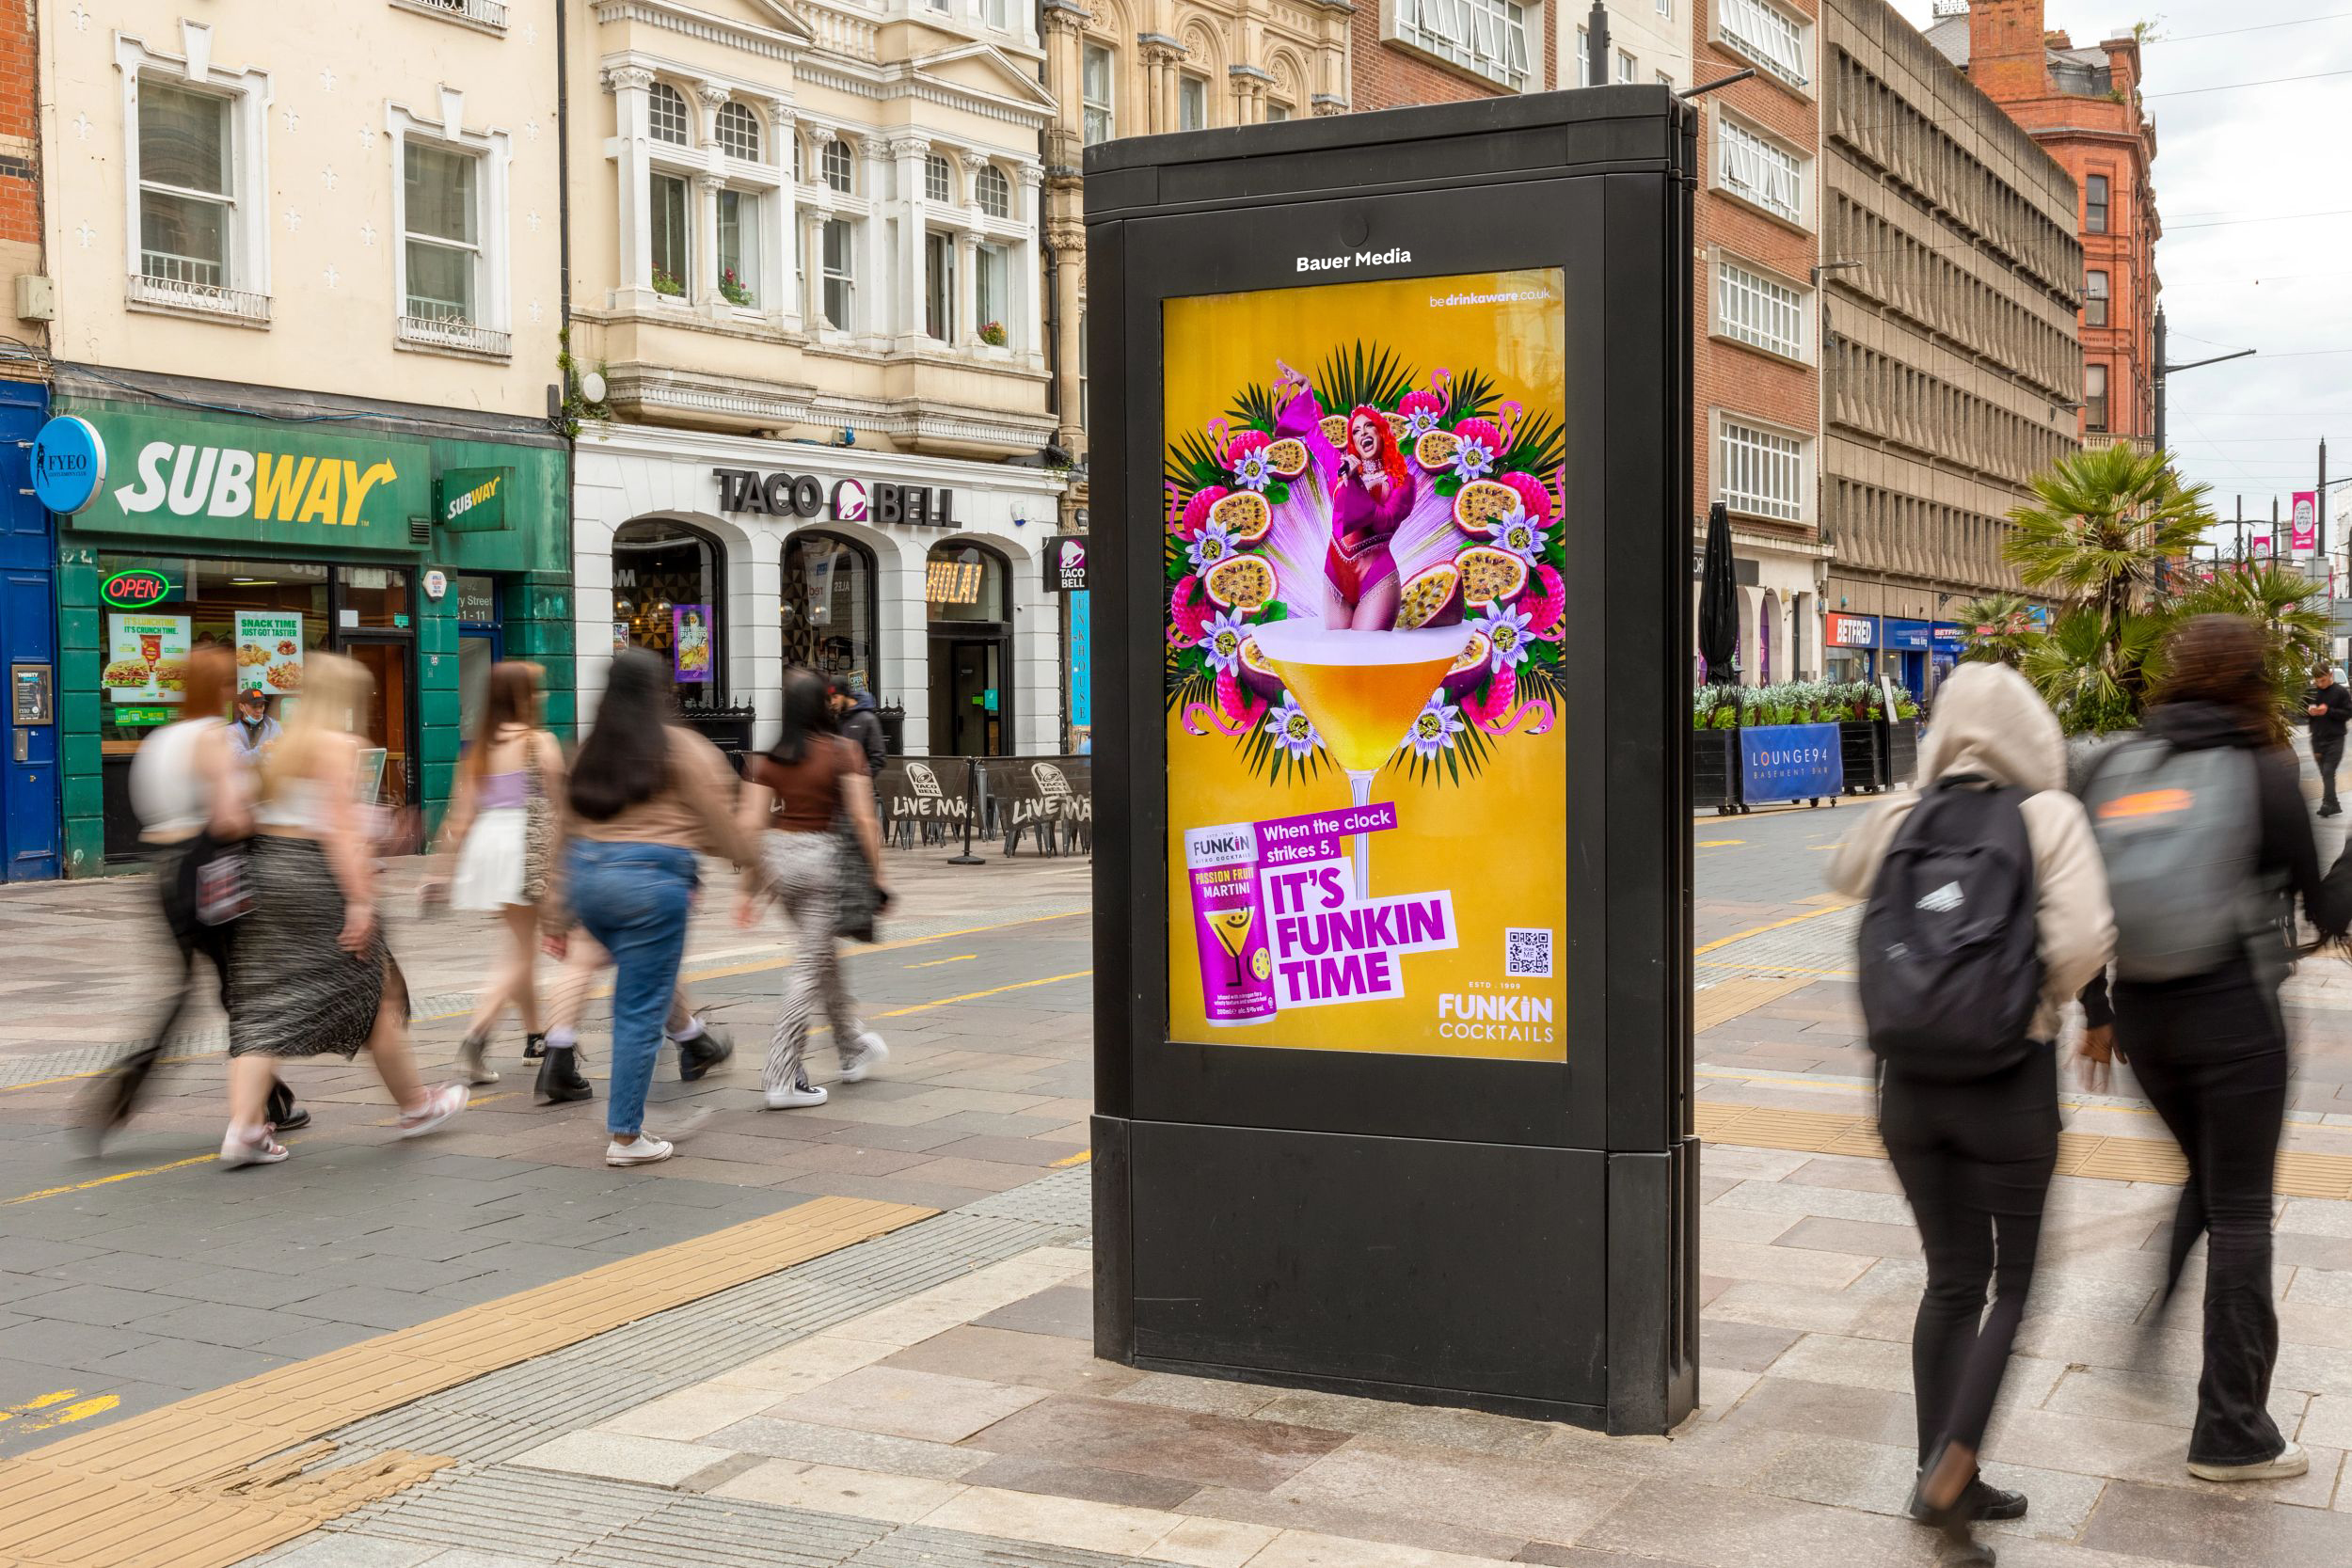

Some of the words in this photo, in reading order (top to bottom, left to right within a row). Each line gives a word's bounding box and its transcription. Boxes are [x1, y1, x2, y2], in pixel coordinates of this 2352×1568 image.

[1296, 256, 1351, 272] Bauer
[1355, 247, 1411, 267] Media
[48, 453, 87, 470] FYEO
[114, 440, 398, 527] SUBWAY
[447, 475, 501, 520] SUBWAY
[712, 467, 824, 518] TACO
[872, 483, 962, 529] BELL
[1059, 568, 1086, 578] TACO
[1061, 578, 1086, 589] BELL
[109, 577, 160, 598] OPEN
[468, 594, 492, 606] Street
[241, 618, 273, 628] SNACK
[275, 619, 297, 628] TIME
[476, 610, 485, 621] 11
[241, 627, 257, 637] JUST
[258, 628, 271, 637] GOT
[272, 628, 297, 637] TASTIER
[1836, 618, 1872, 644] BETFRED
[1077, 591, 1087, 719] UNKHOUSE
[1753, 748, 1827, 767] LOUNGE94
[1754, 768, 1804, 780] BASEMENT
[1811, 767, 1828, 775] BAR
[1263, 824, 1310, 842] When
[1313, 818, 1340, 834] the
[1343, 809, 1391, 830] clock
[1216, 853, 1250, 862] COCKTAILS
[1266, 845, 1316, 863] strikes
[1320, 840, 1335, 856] 5,
[1195, 869, 1231, 885] PASSION
[1203, 881, 1250, 898] MARTINI
[1269, 866, 1345, 915] IT'S
[1276, 899, 1446, 958] FUNKIN
[1279, 951, 1391, 1002] TIME
[1439, 1022, 1554, 1043] COCKTAILS
